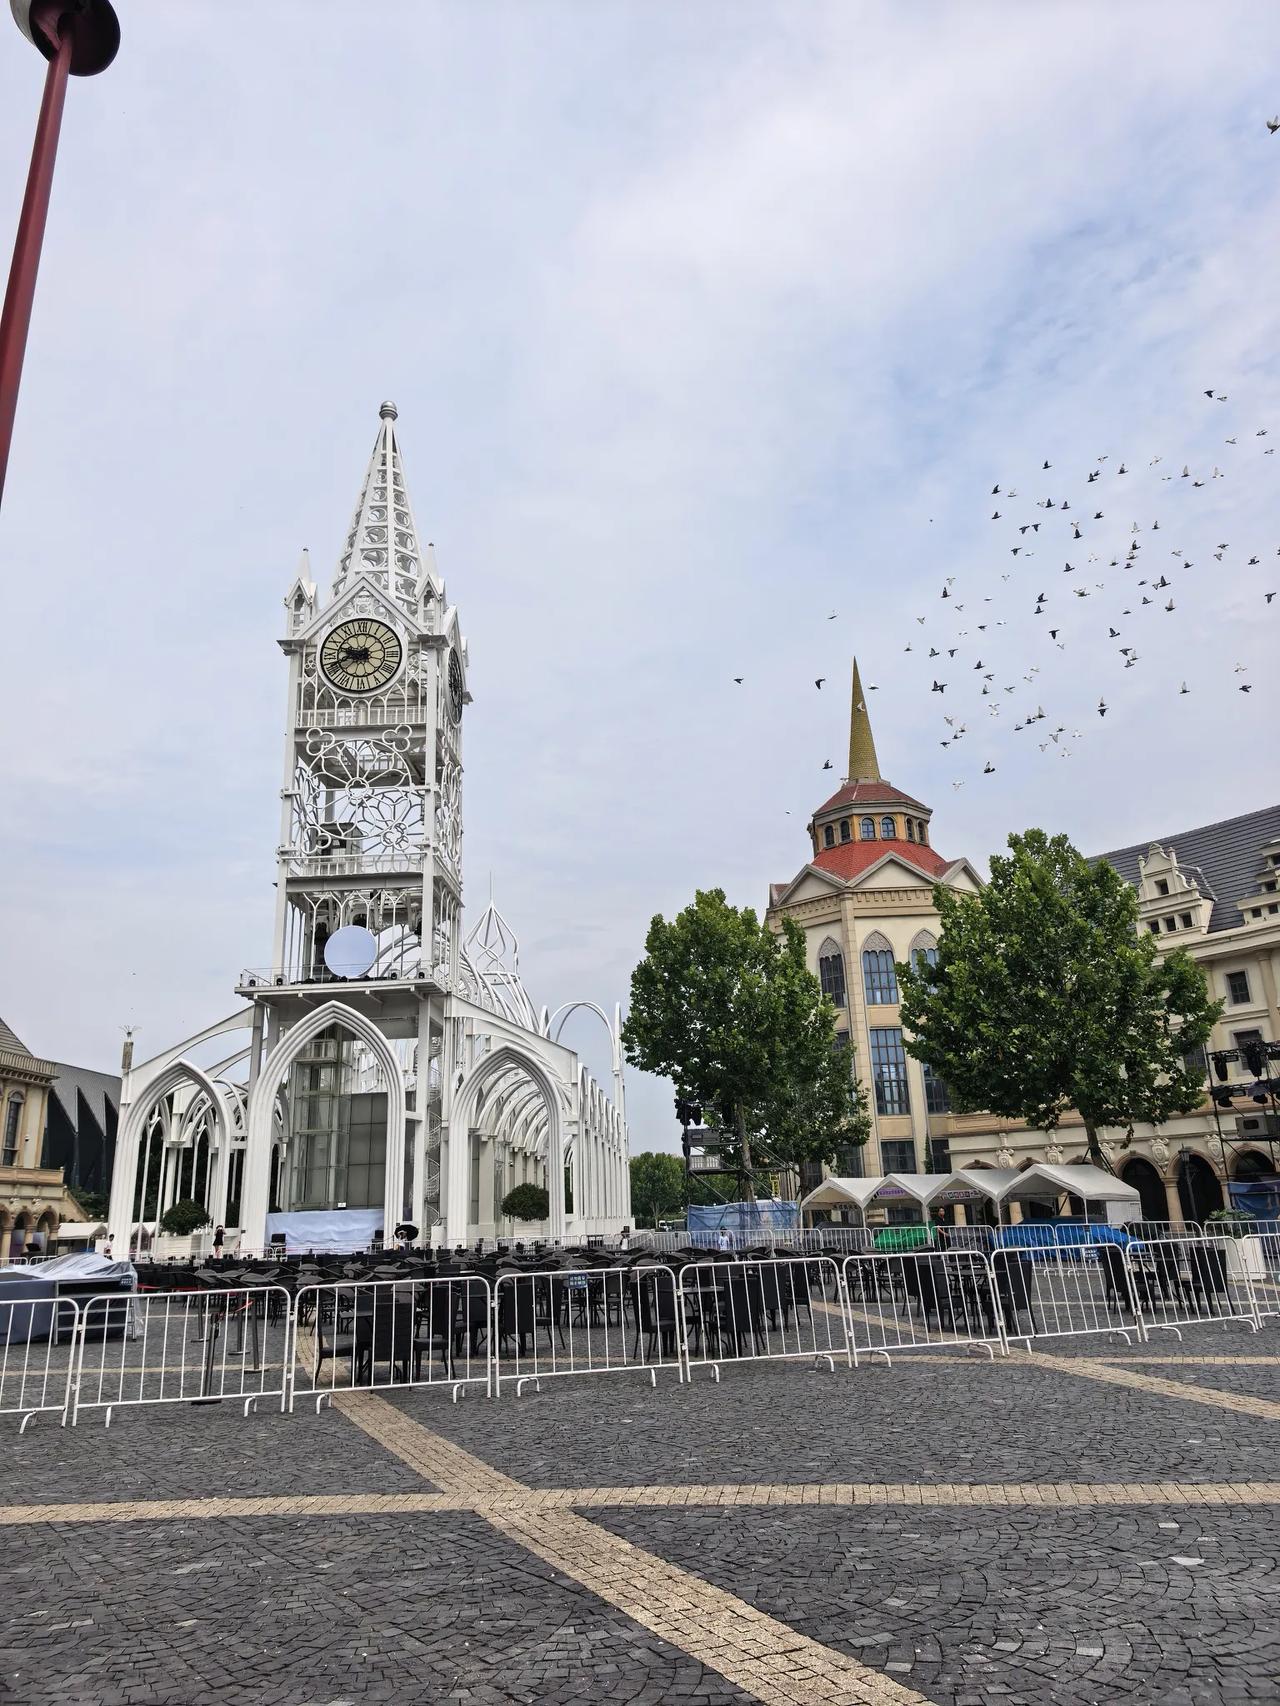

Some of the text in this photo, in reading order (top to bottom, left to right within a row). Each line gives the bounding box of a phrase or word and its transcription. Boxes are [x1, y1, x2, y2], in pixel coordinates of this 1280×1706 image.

[341, 626, 353, 638] XI
[357, 622, 368, 632] XII
[328, 637, 341, 647] X
[382, 636, 395, 644] II
[324, 652, 336, 660] IX
[357, 679, 365, 689] VI
[373, 675, 381, 685] V
